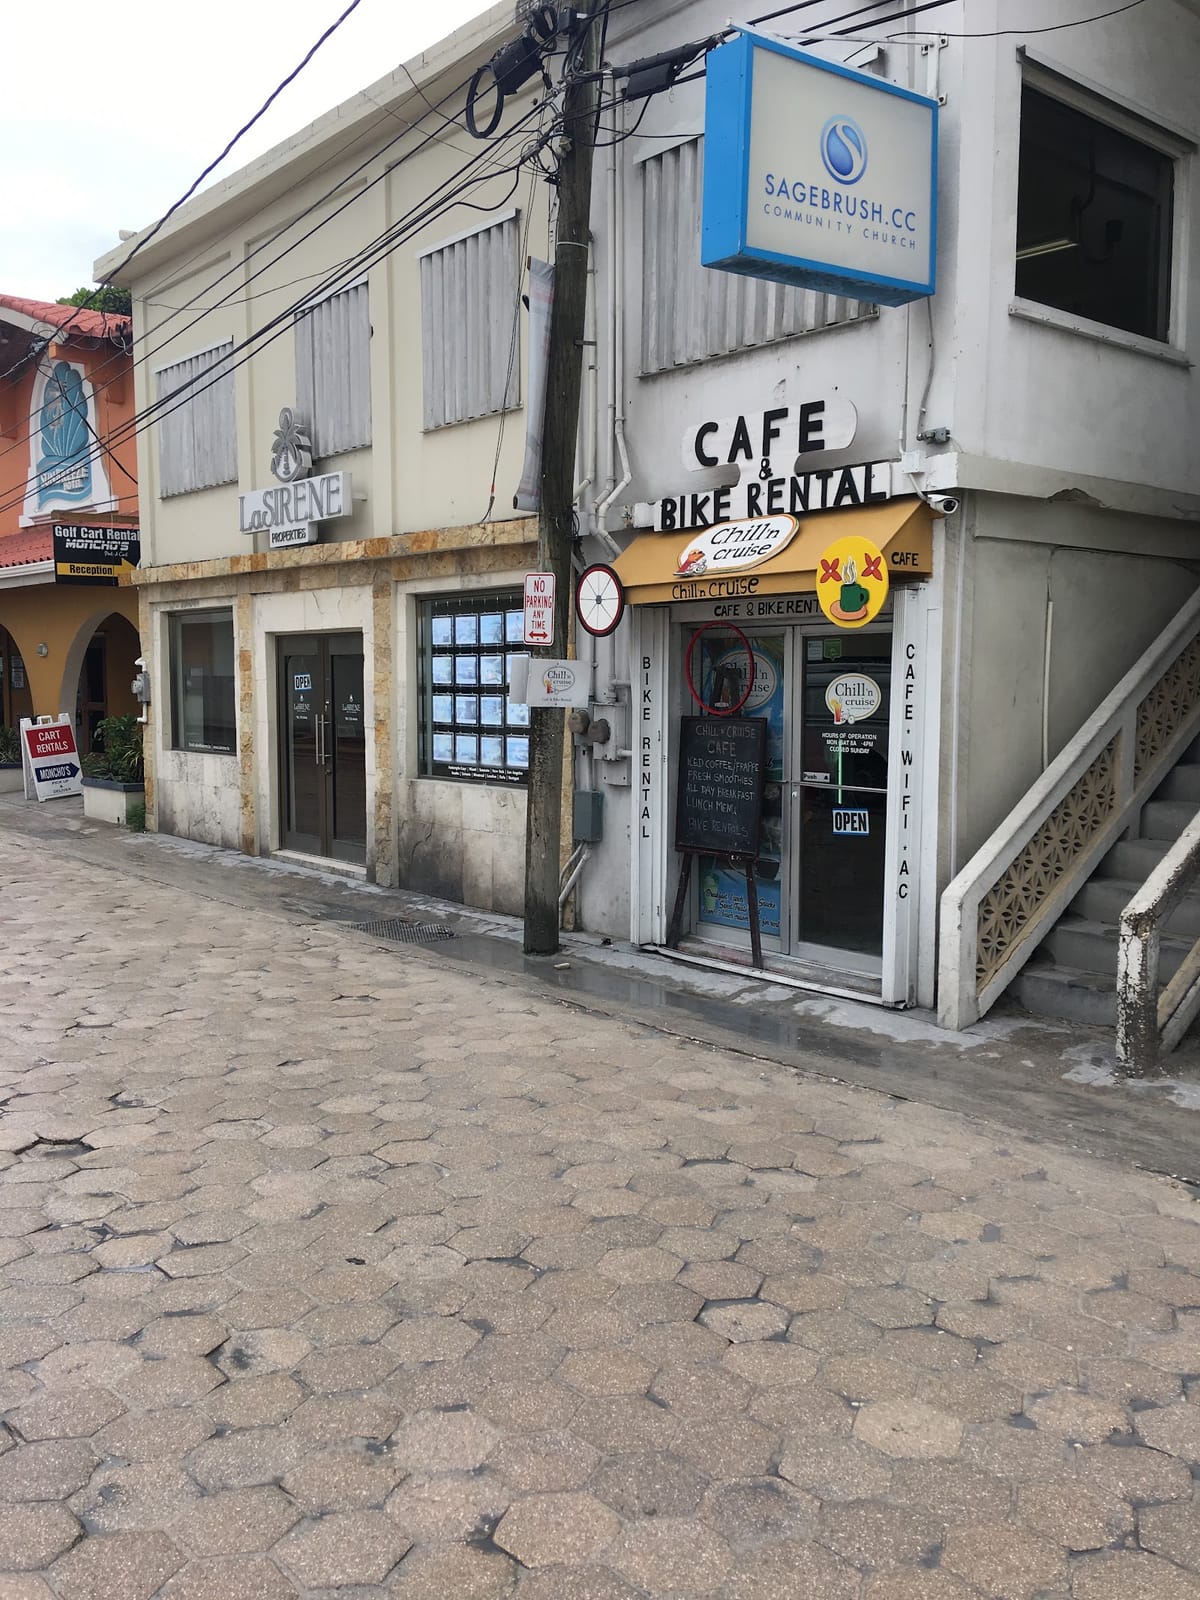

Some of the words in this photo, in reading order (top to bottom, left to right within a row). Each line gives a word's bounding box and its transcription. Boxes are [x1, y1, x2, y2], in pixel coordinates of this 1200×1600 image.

[765, 174, 916, 232] SAGEBRUSH.CC
[764, 203, 852, 234] COMMUNITY
[863, 228, 916, 249] CHURCH
[694, 400, 825, 467] CAFE
[759, 458, 773, 480] &
[661, 488, 731, 530] BIKE
[747, 462, 887, 518] RENTAL
[54, 526, 77, 538] Golf
[80, 526, 103, 540] Cart
[271, 528, 307, 543] PROPERTIES
[711, 523, 780, 545] Chill'n
[713, 544, 772, 561] cruise
[891, 551, 919, 567] CAFE
[69, 565, 113, 576] Reception
[533, 580, 545, 592] NO
[526, 595, 552, 609] PARKING
[714, 604, 740, 617] CAFE
[746, 601, 754, 616] &
[757, 601, 784, 615] BIKE
[786, 599, 823, 614] RENT
[532, 610, 545, 619] ANY
[531, 620, 545, 630] TIME
[295, 676, 311, 688] OPEN
[642, 656, 652, 721] BIKE
[905, 643, 915, 721] CAFE
[845, 697, 875, 706] cruise
[38, 730, 60, 741] CART
[695, 723, 719, 737] CHILL
[726, 725, 756, 739] CRUISE
[36, 741, 69, 754] RENTALS
[707, 740, 737, 757] CAFE
[40, 766, 71, 779] MONCHO'S
[687, 770, 712, 781] FRESH
[641, 736, 651, 838] RENTAL
[701, 785, 715, 797] DAY
[686, 796, 713, 811] LUNCH
[834, 811, 867, 832] OPEN
[898, 859, 909, 900] AC
